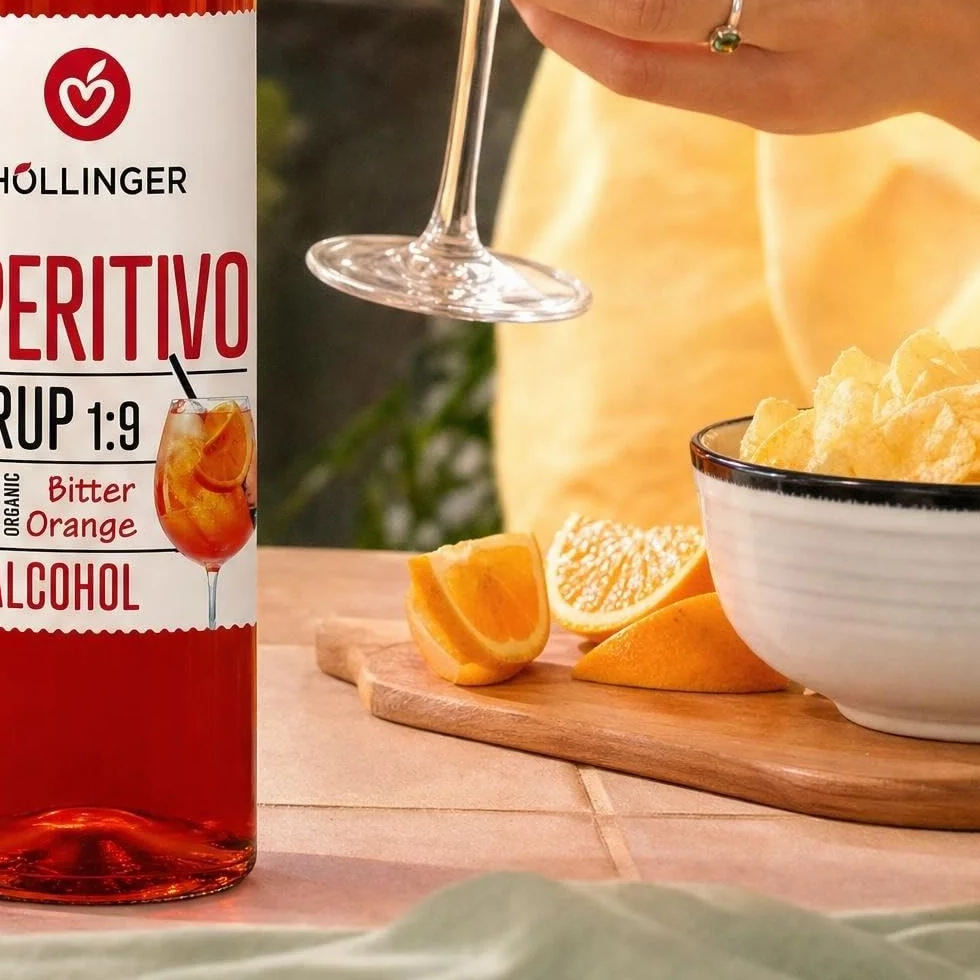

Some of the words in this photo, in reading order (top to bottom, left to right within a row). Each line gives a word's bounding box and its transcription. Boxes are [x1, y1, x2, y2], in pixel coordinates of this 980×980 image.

[87, 401, 140, 451] 1:9
[3, 473, 20, 536] ORGANIC
[48, 475, 136, 503] Bitter
[26, 510, 138, 544] Orange
